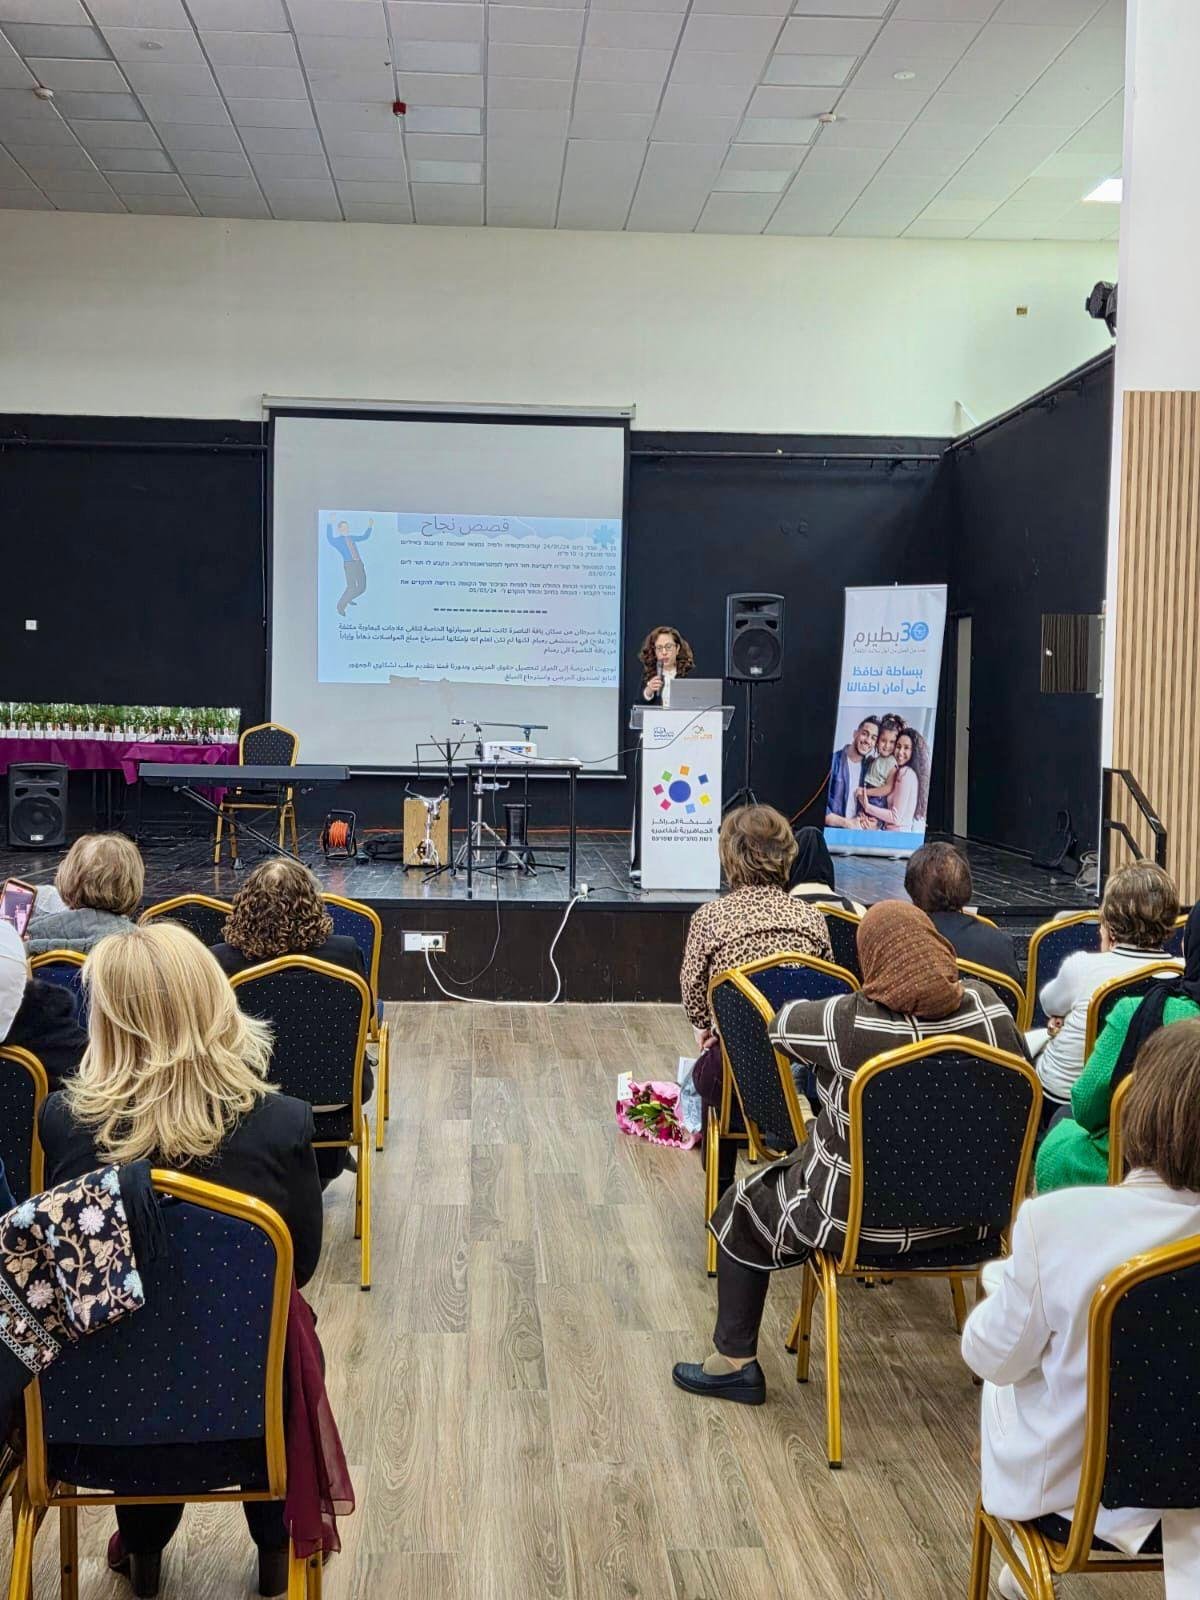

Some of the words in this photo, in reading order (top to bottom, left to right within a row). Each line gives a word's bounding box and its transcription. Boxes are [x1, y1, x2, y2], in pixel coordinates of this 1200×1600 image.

[421, 515, 456, 537] نجاح
[459, 518, 510, 536] قصص
[853, 625, 899, 648] بطيرم
[852, 665, 883, 677] نحافظ
[886, 665, 924, 679] ببساطة
[882, 679, 904, 695] أمان
[905, 681, 927, 695] على
